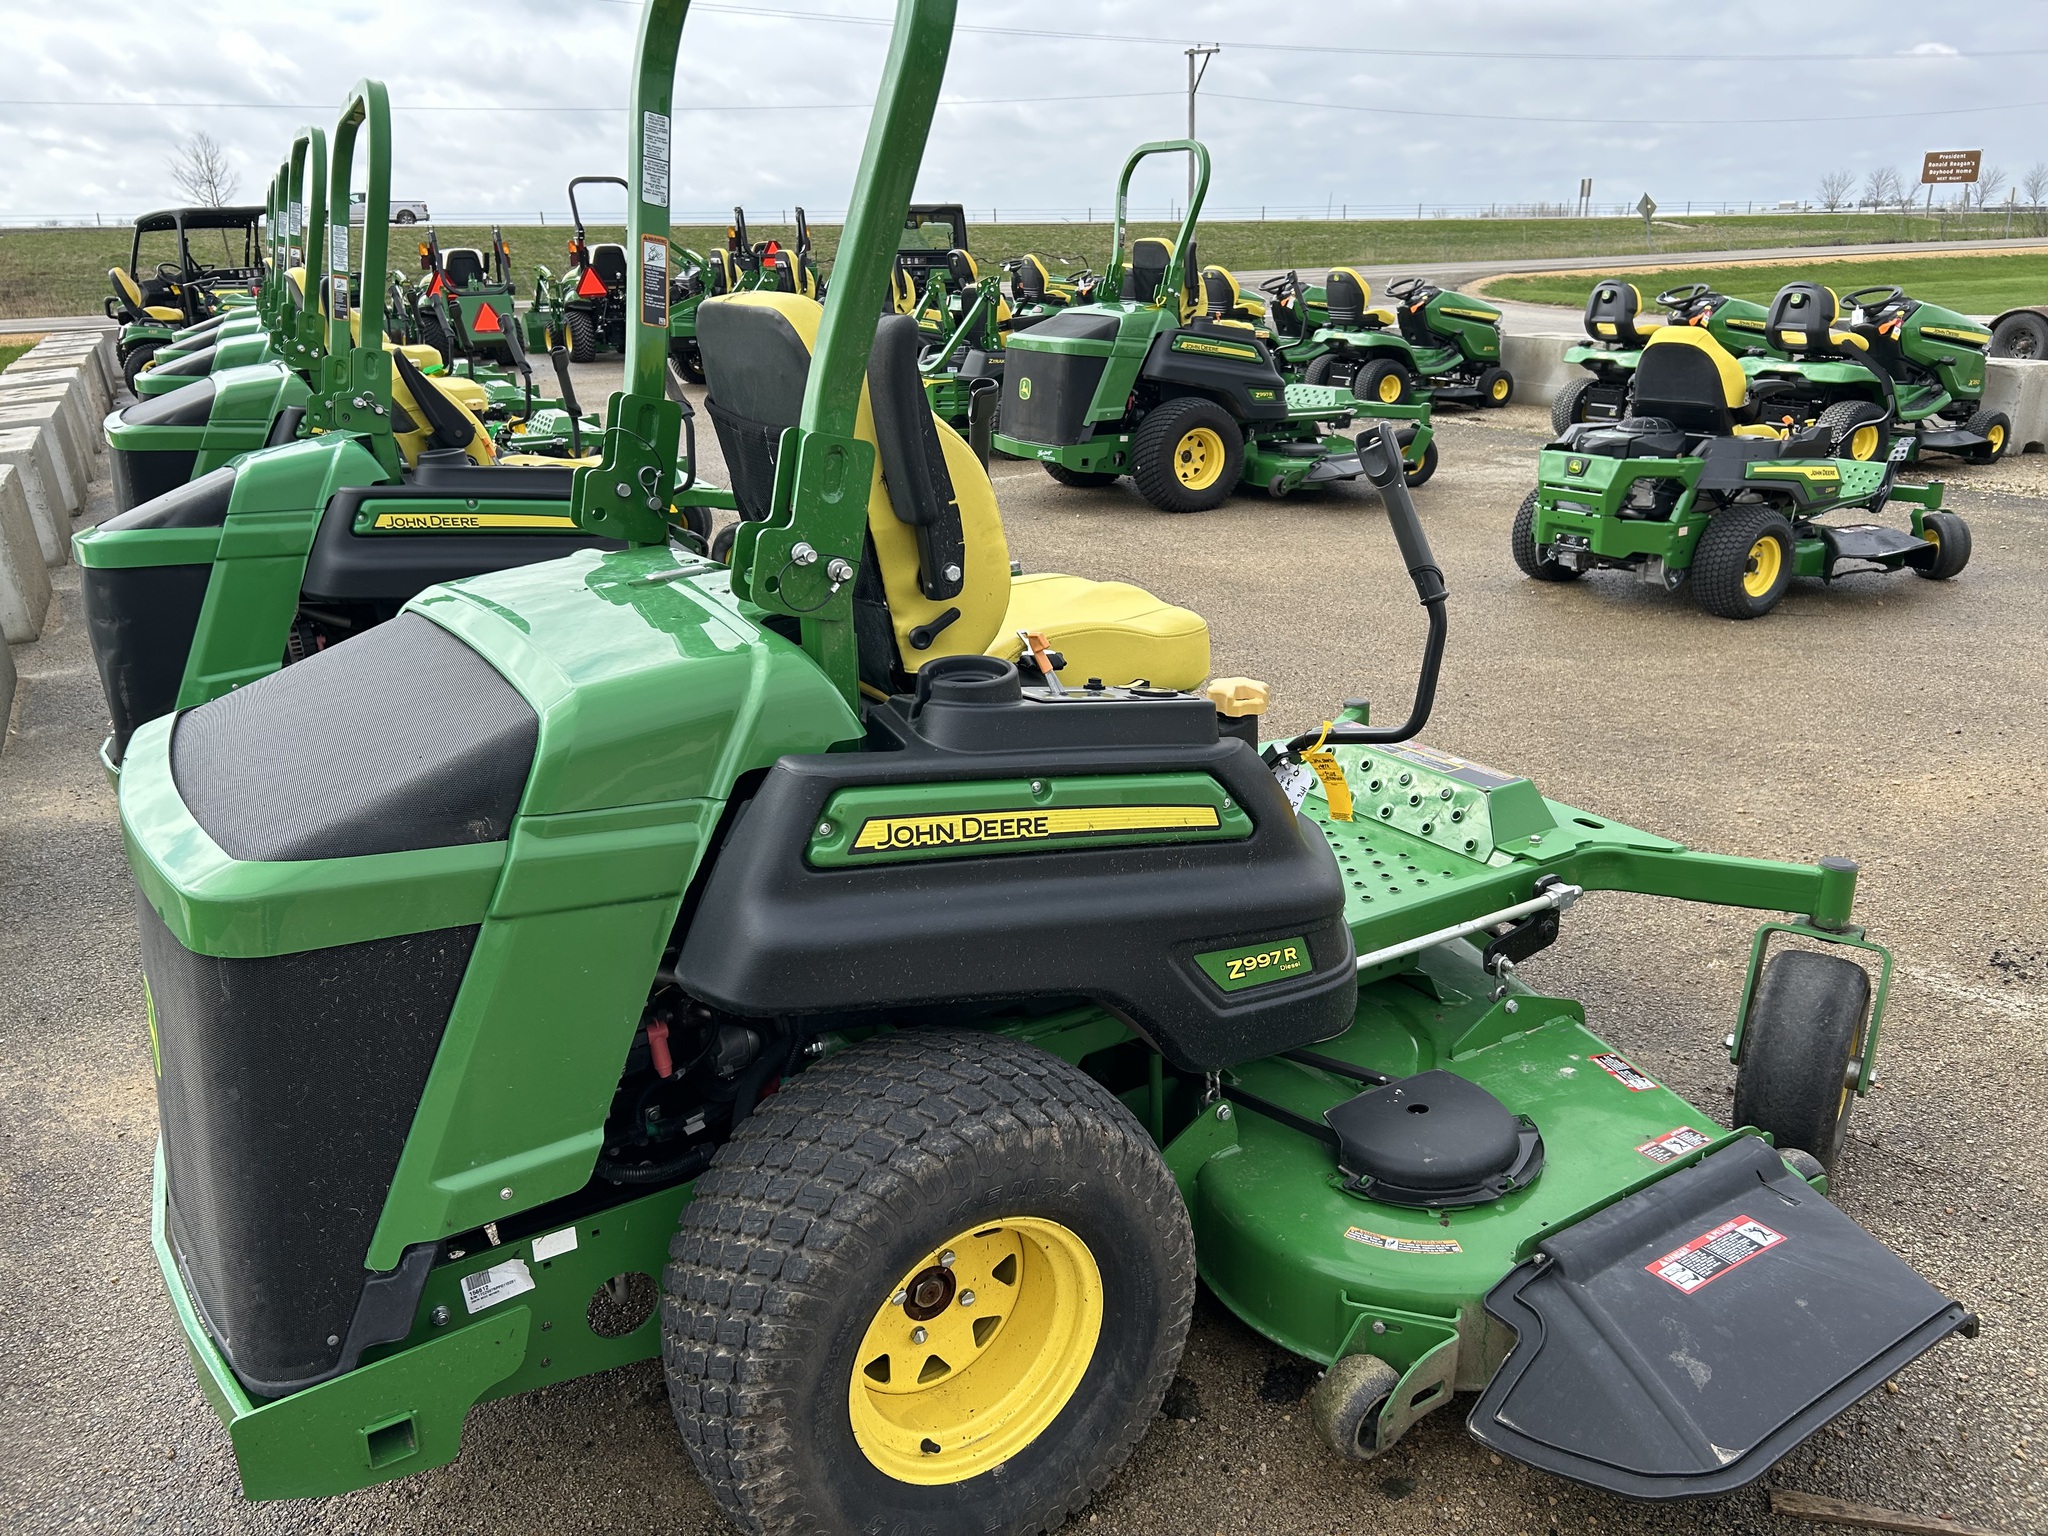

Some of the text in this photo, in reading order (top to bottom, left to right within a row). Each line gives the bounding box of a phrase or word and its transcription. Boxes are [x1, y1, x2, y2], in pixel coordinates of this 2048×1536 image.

[1950, 160, 1975, 168] Reagan's
[1185, 343, 1218, 353] JOHN DEERE
[386, 515, 480, 528] JOHN DEERE
[877, 816, 1049, 848] JOHN DEERE
[1226, 947, 1298, 980] Z997R
[1280, 961, 1301, 971] Diesel
